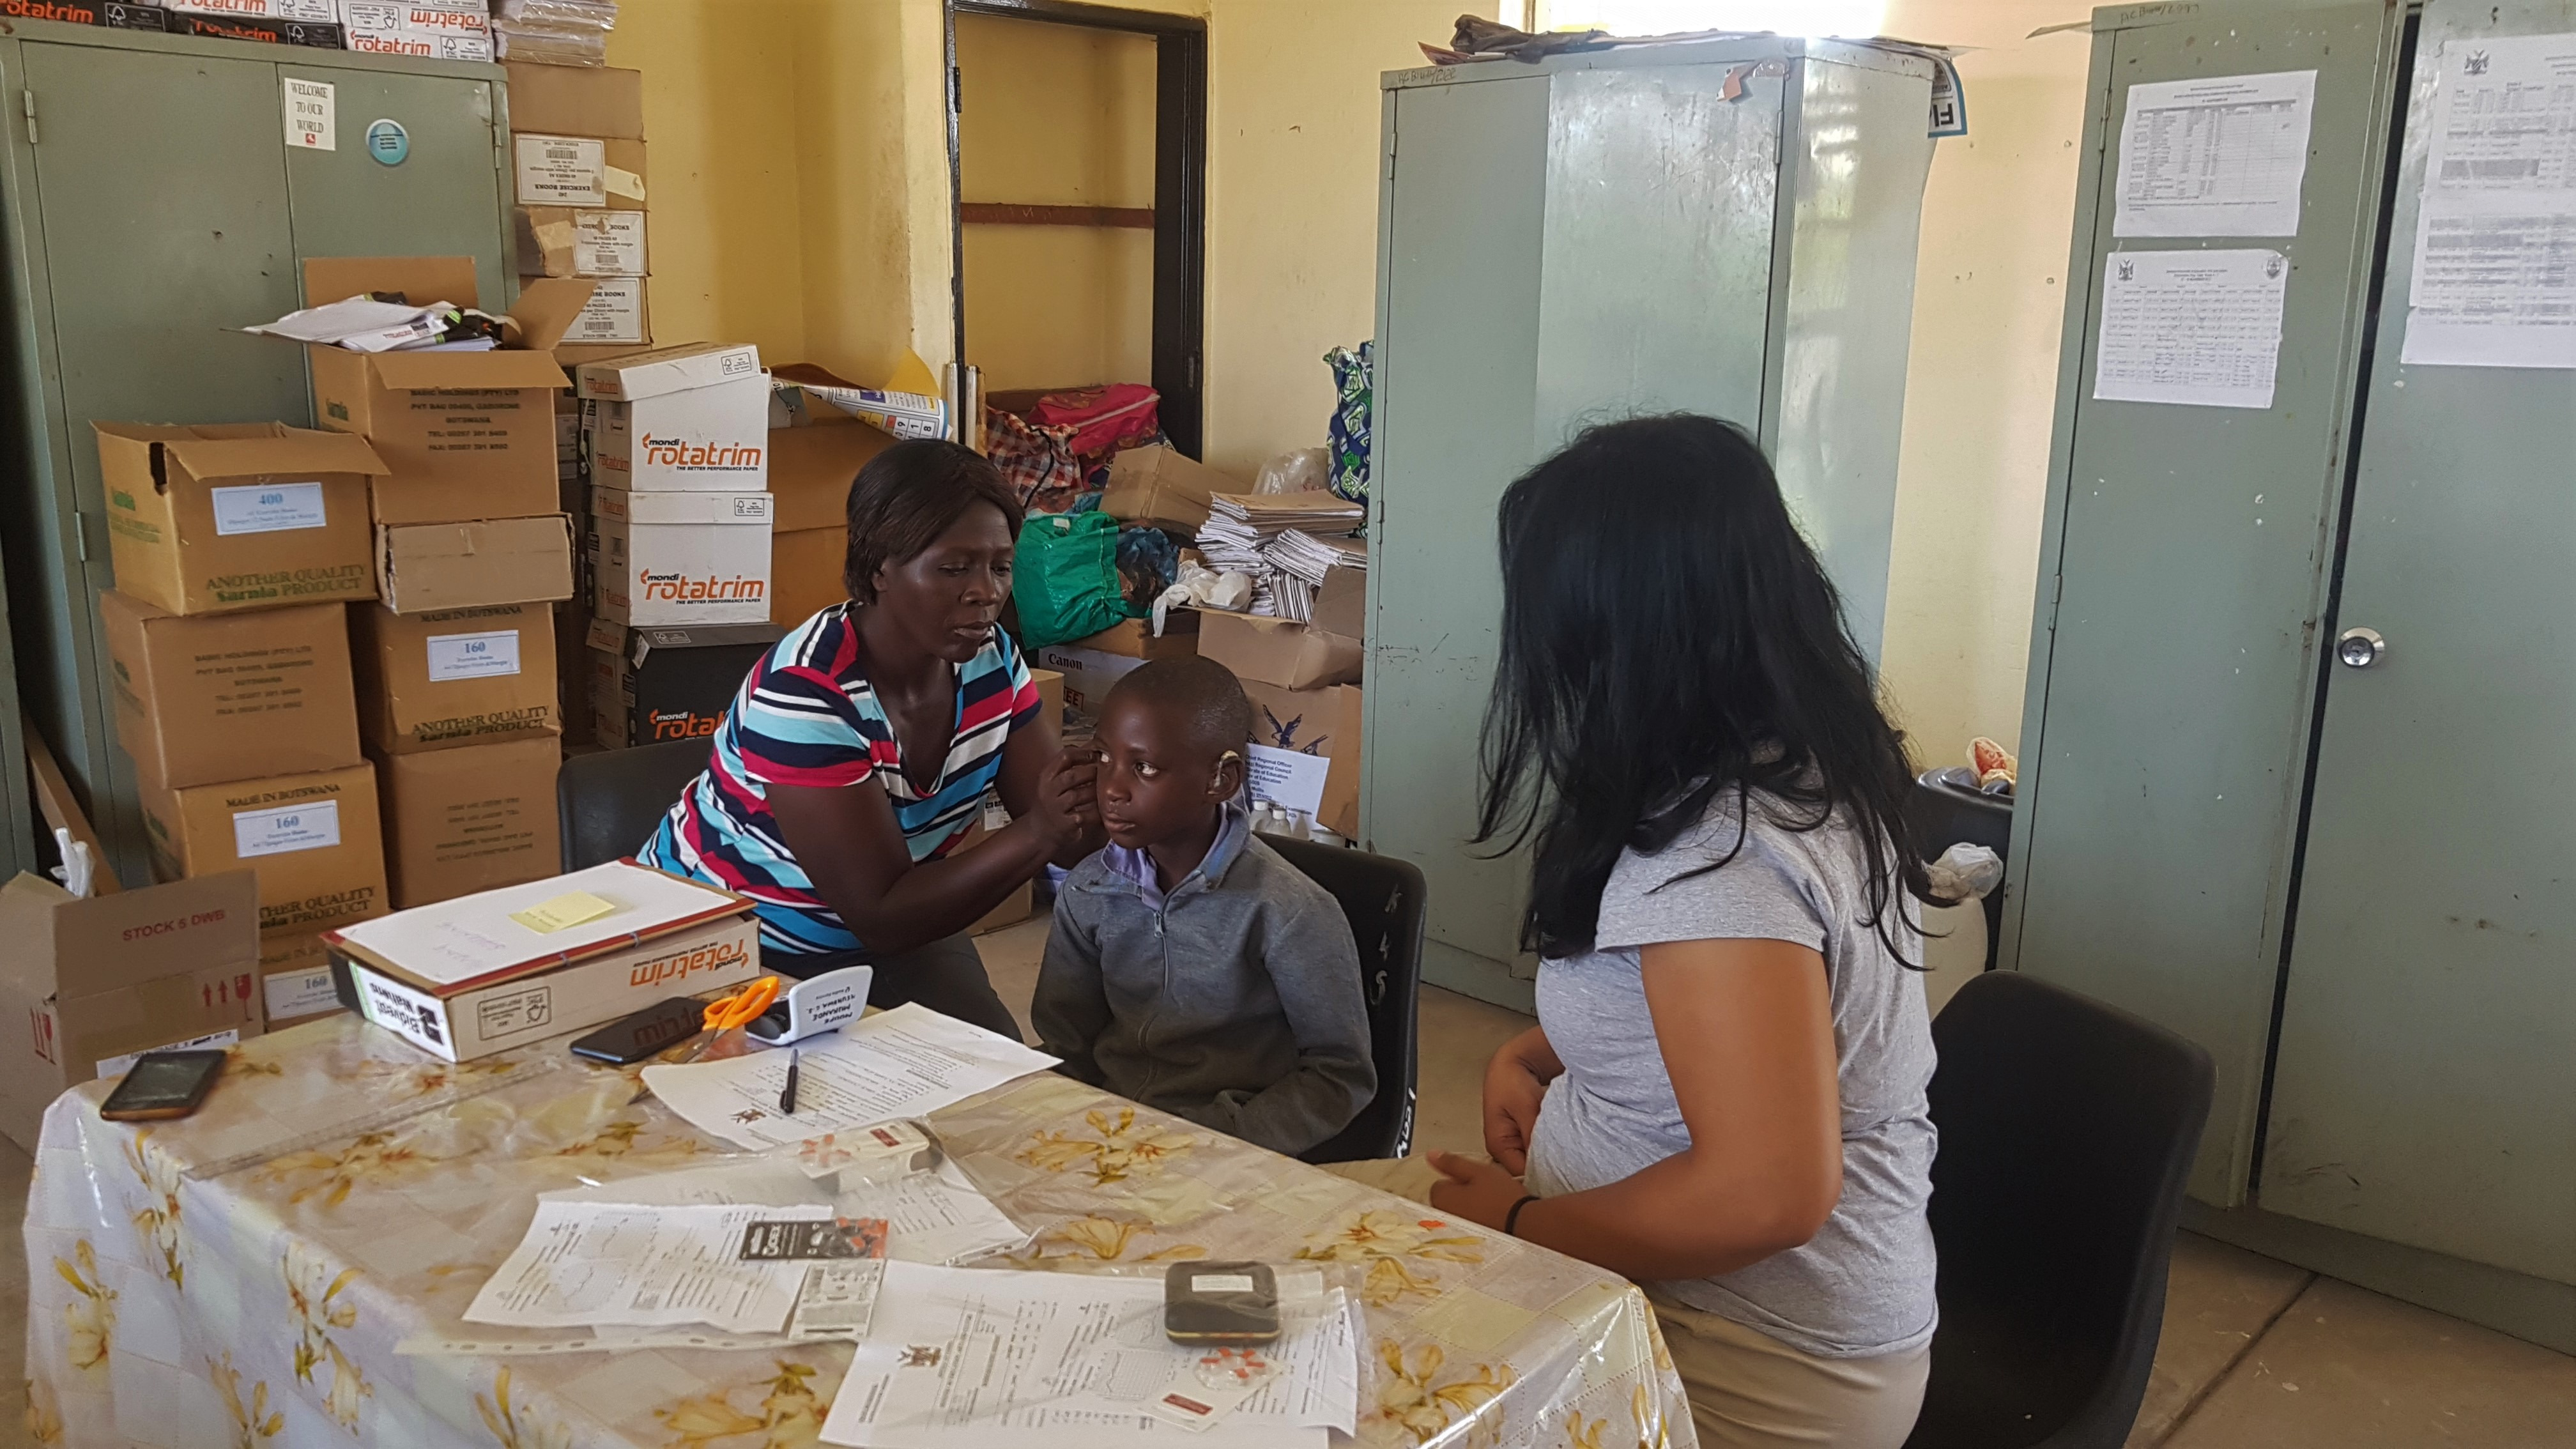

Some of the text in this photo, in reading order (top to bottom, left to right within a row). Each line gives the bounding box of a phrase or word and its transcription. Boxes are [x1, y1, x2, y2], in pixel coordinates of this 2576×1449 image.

[0, 0, 94, 24] otatrim
[410, 10, 484, 27] rotatrim
[355, 36, 431, 56] rotatrim
[291, 82, 328, 98] WELCOME
[296, 101, 323, 115] TO OUR
[1930, 103, 1954, 127] FI
[296, 119, 325, 133] WORLD
[647, 441, 762, 466] rotatrim
[258, 493, 283, 506] 400
[206, 570, 291, 590] ANOTHER
[294, 564, 366, 581] QUALITY
[647, 573, 680, 581] mondi
[282, 578, 362, 597] PRODUCT
[645, 574, 765, 601] rotatrim
[453, 611, 465, 620] IN
[468, 606, 523, 618] BOTSWANA
[464, 641, 486, 654] 160
[1048, 653, 1083, 670] Canon
[412, 705, 549, 734] ANOTHER QUALITY
[656, 711, 689, 721] mondi
[475, 718, 546, 735] PRODUCT
[226, 784, 341, 808] MADE IN BOTSWANA
[275, 815, 300, 829] 160
[259, 886, 376, 919] THER QUALITY
[291, 899, 372, 923] PRODUCT
[123, 920, 174, 941] STOCK
[191, 909, 225, 926] DWB
[629, 938, 745, 986] rotatrim
[714, 956, 743, 971] mondi
[305, 975, 327, 989] 160
